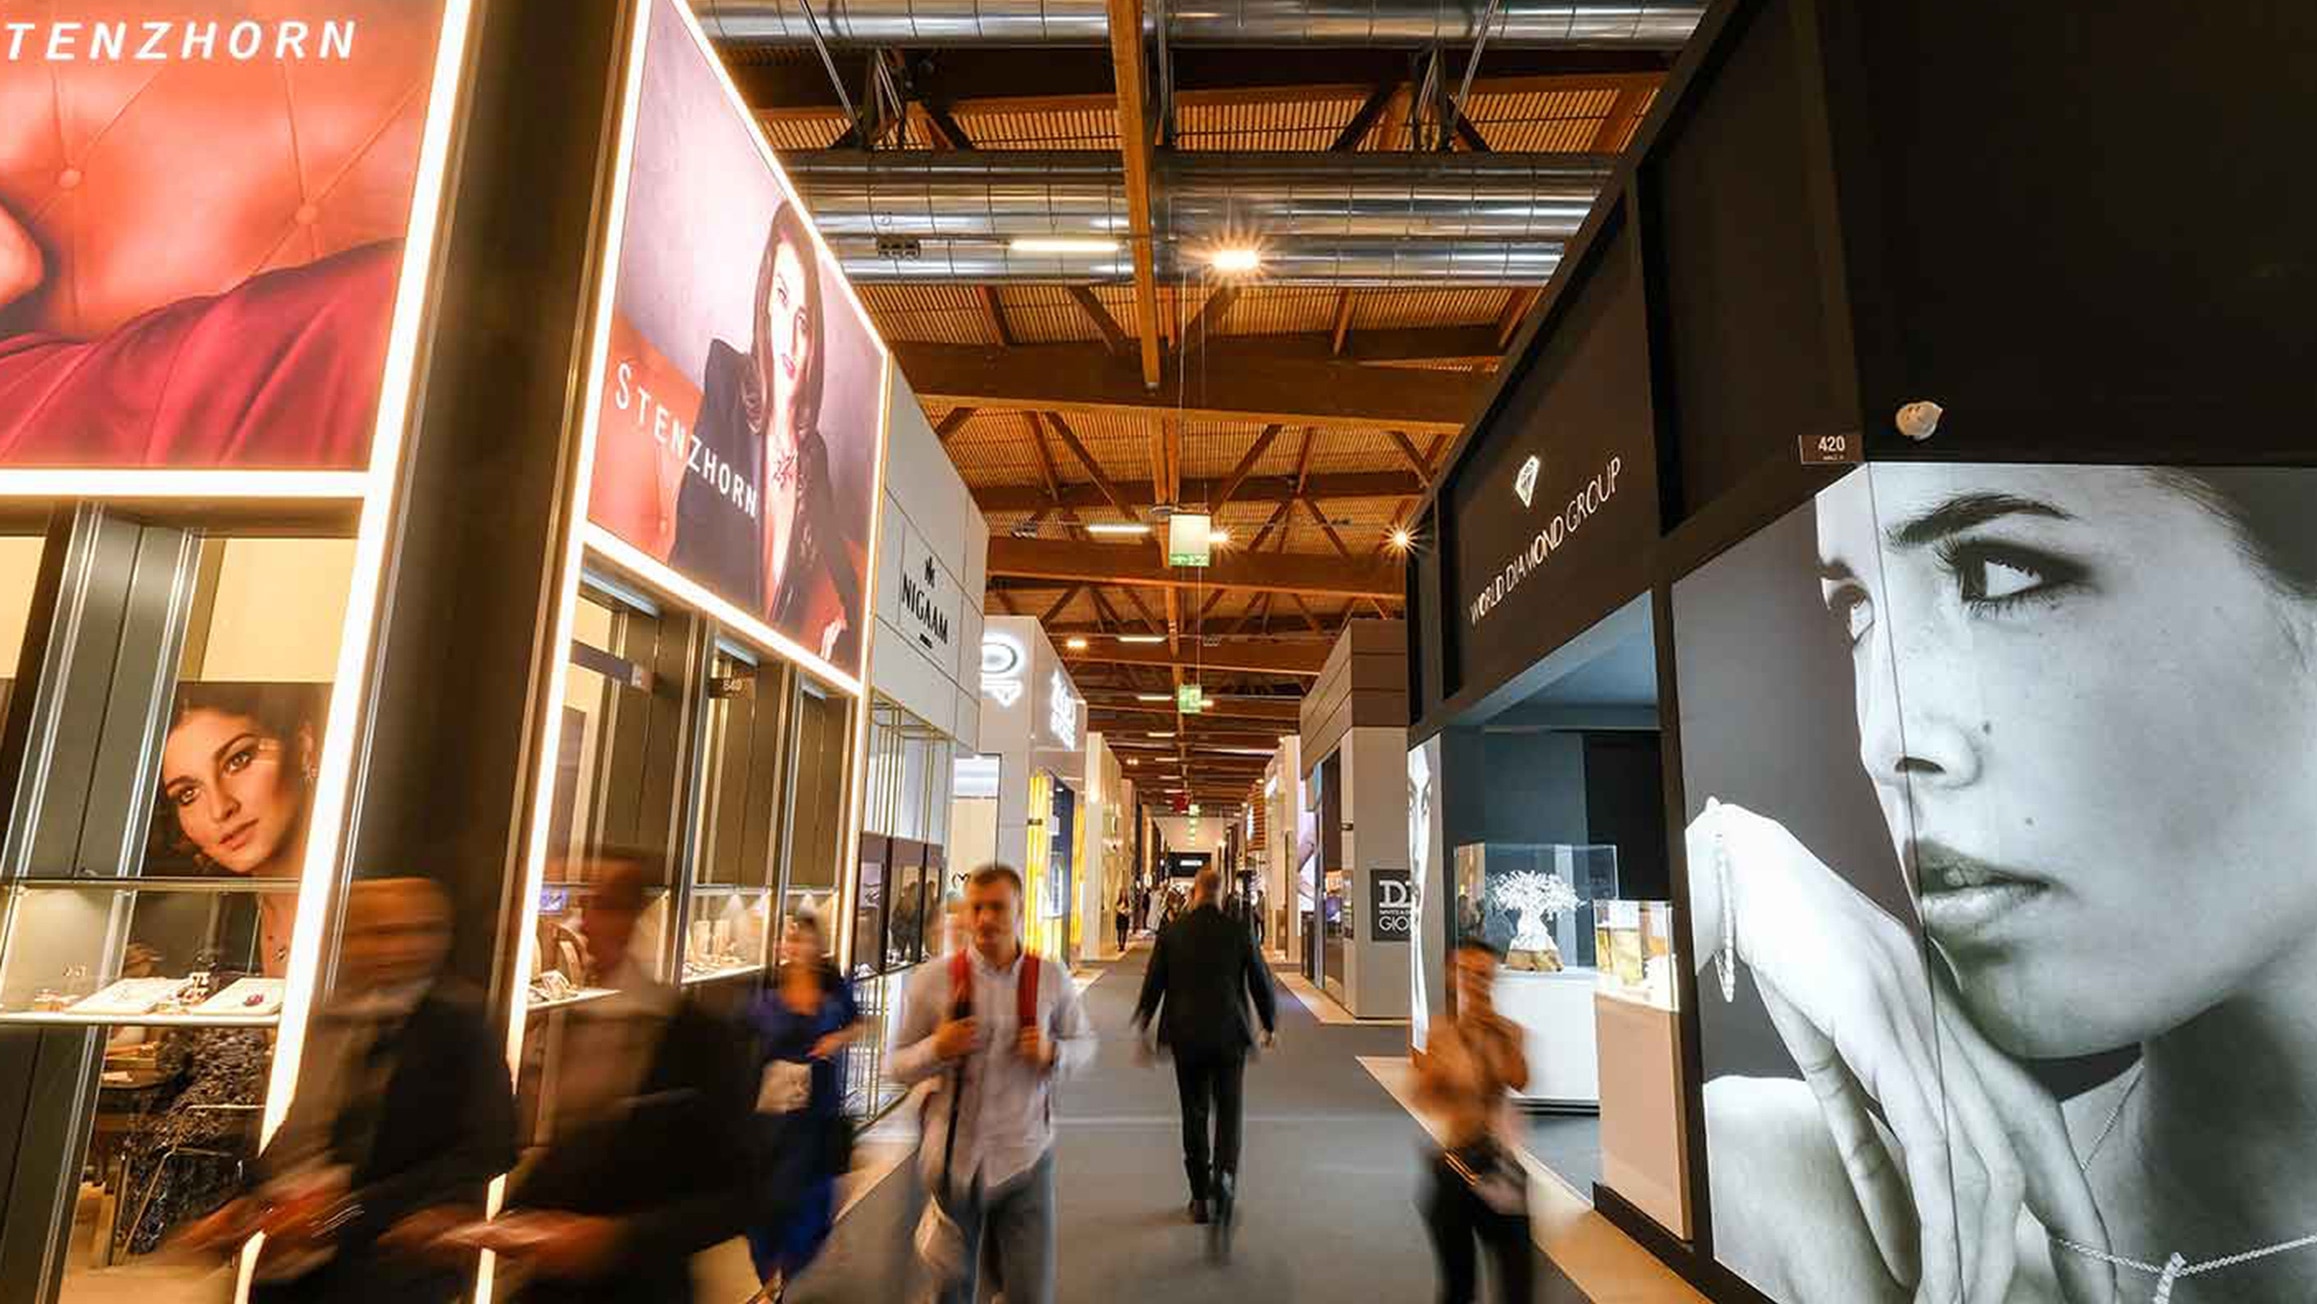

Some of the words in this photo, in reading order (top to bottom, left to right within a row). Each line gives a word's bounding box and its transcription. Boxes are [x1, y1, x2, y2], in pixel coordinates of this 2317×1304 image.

[5, 20, 356, 61] TENZHORN
[615, 362, 758, 518] STENZHORN
[1818, 435, 1846, 451] 420
[1469, 575, 1505, 625] WORLD
[1505, 515, 1565, 593] DIAMOND
[1566, 456, 1622, 533] GROUP
